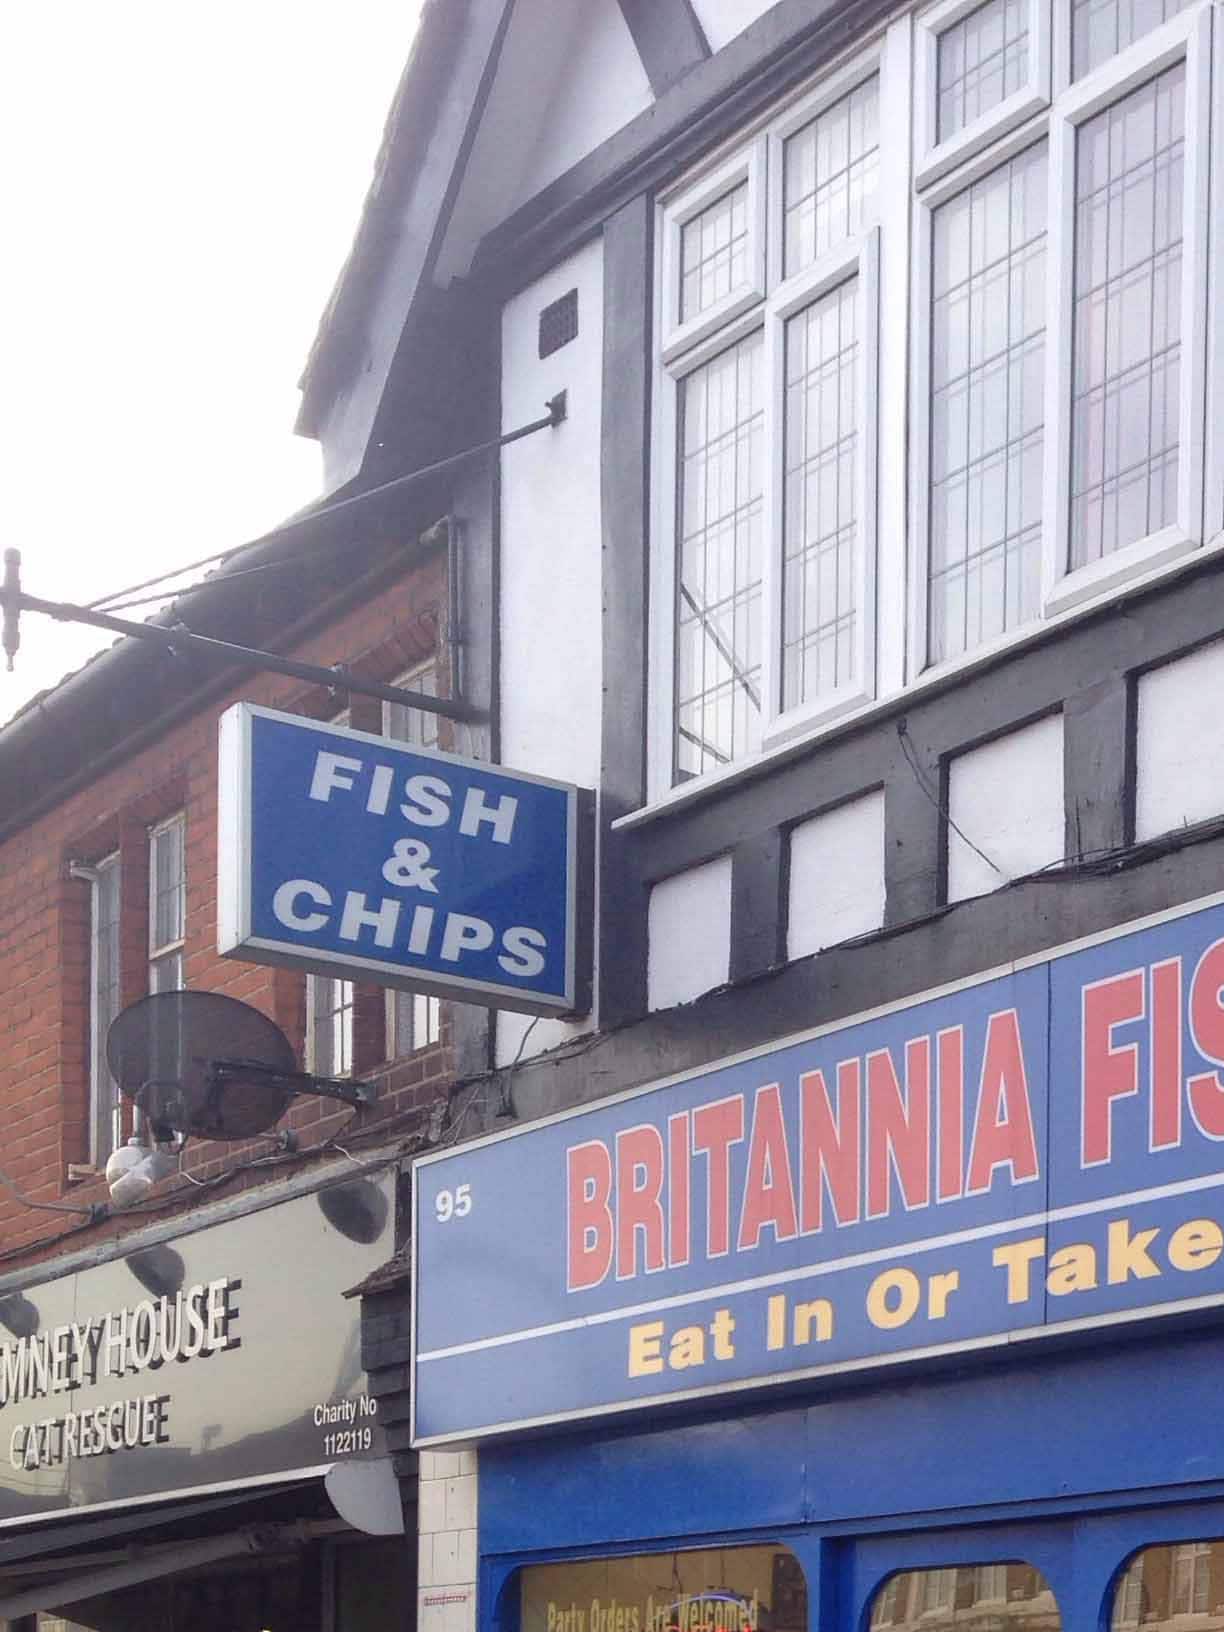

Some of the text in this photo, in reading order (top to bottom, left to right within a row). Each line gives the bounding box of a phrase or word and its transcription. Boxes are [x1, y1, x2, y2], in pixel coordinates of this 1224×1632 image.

[308, 750, 519, 845] FISH
[382, 838, 441, 894] &
[272, 879, 548, 977] CHIPS
[566, 1008, 1040, 1293] BRITANNIA
[435, 1184, 473, 1223] 95
[104, 1277, 230, 1377] HOUSE
[628, 1306, 735, 1379] Eat
[767, 1295, 833, 1352] In
[866, 1267, 959, 1329] Or
[993, 1218, 1224, 1304] Take
[10, 1394, 160, 1471] CAT RESCUE
[313, 1396, 377, 1427] Charity No
[323, 1428, 372, 1456] 1122119
